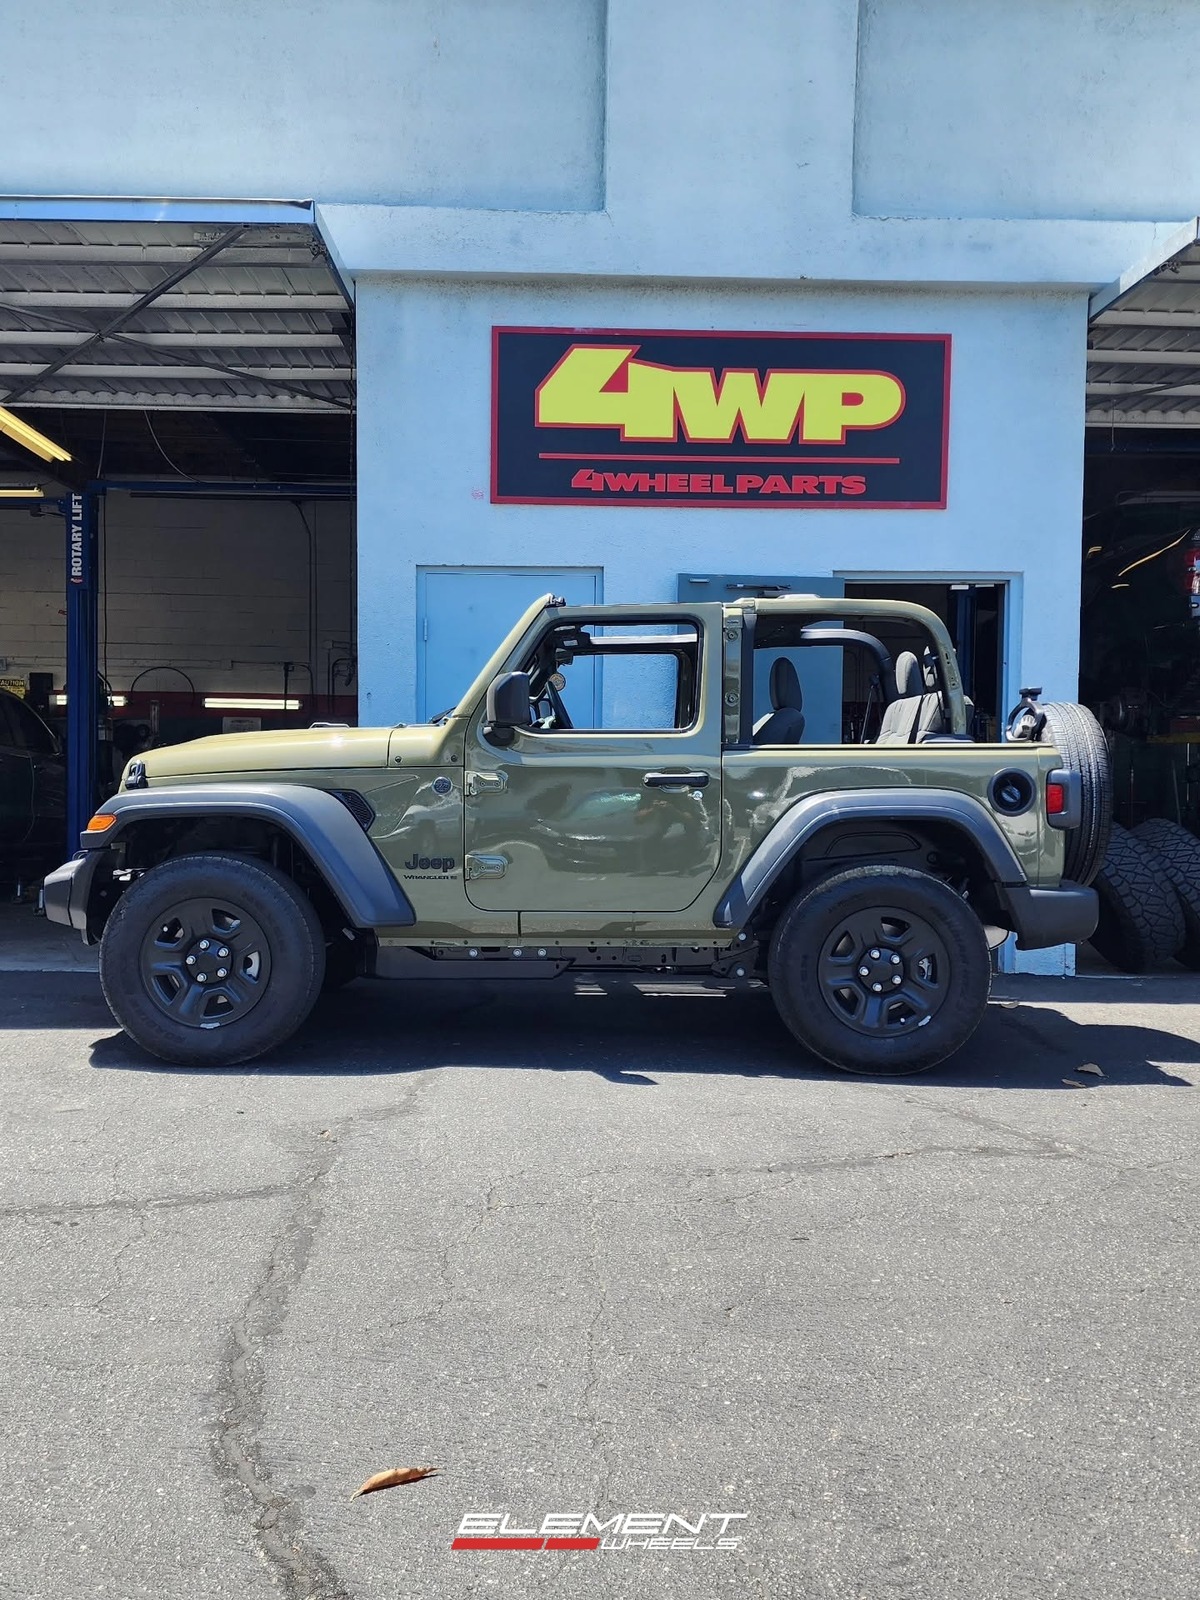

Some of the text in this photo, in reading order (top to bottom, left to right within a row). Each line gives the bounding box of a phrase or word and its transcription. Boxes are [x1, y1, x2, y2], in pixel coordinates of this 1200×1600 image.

[535, 344, 906, 444] 4WP
[736, 474, 866, 494] PARTS
[71, 493, 83, 576] ROTARY LIFT
[0, 679, 24, 687] AUTION
[404, 853, 455, 872] Jeep
